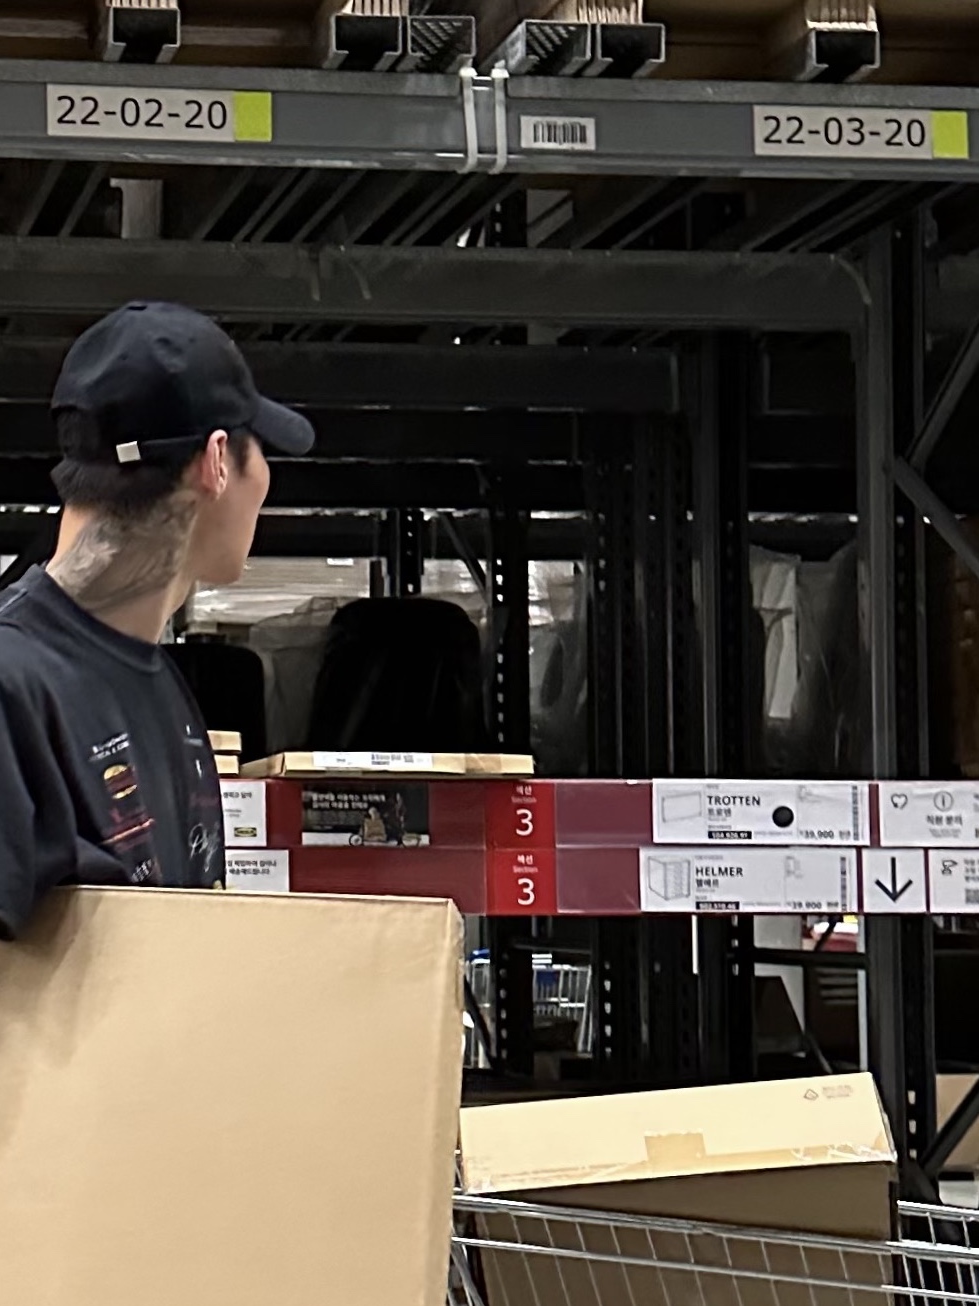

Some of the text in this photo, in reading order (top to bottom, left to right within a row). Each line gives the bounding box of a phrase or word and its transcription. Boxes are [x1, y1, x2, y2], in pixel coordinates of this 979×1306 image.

[56, 94, 229, 130] 22-02-20
[762, 115, 926, 148] 22-03-20
[707, 796, 761, 806] TROTTEN
[515, 808, 533, 836] 3
[695, 867, 743, 877] HELMER
[517, 878, 535, 906] 3
